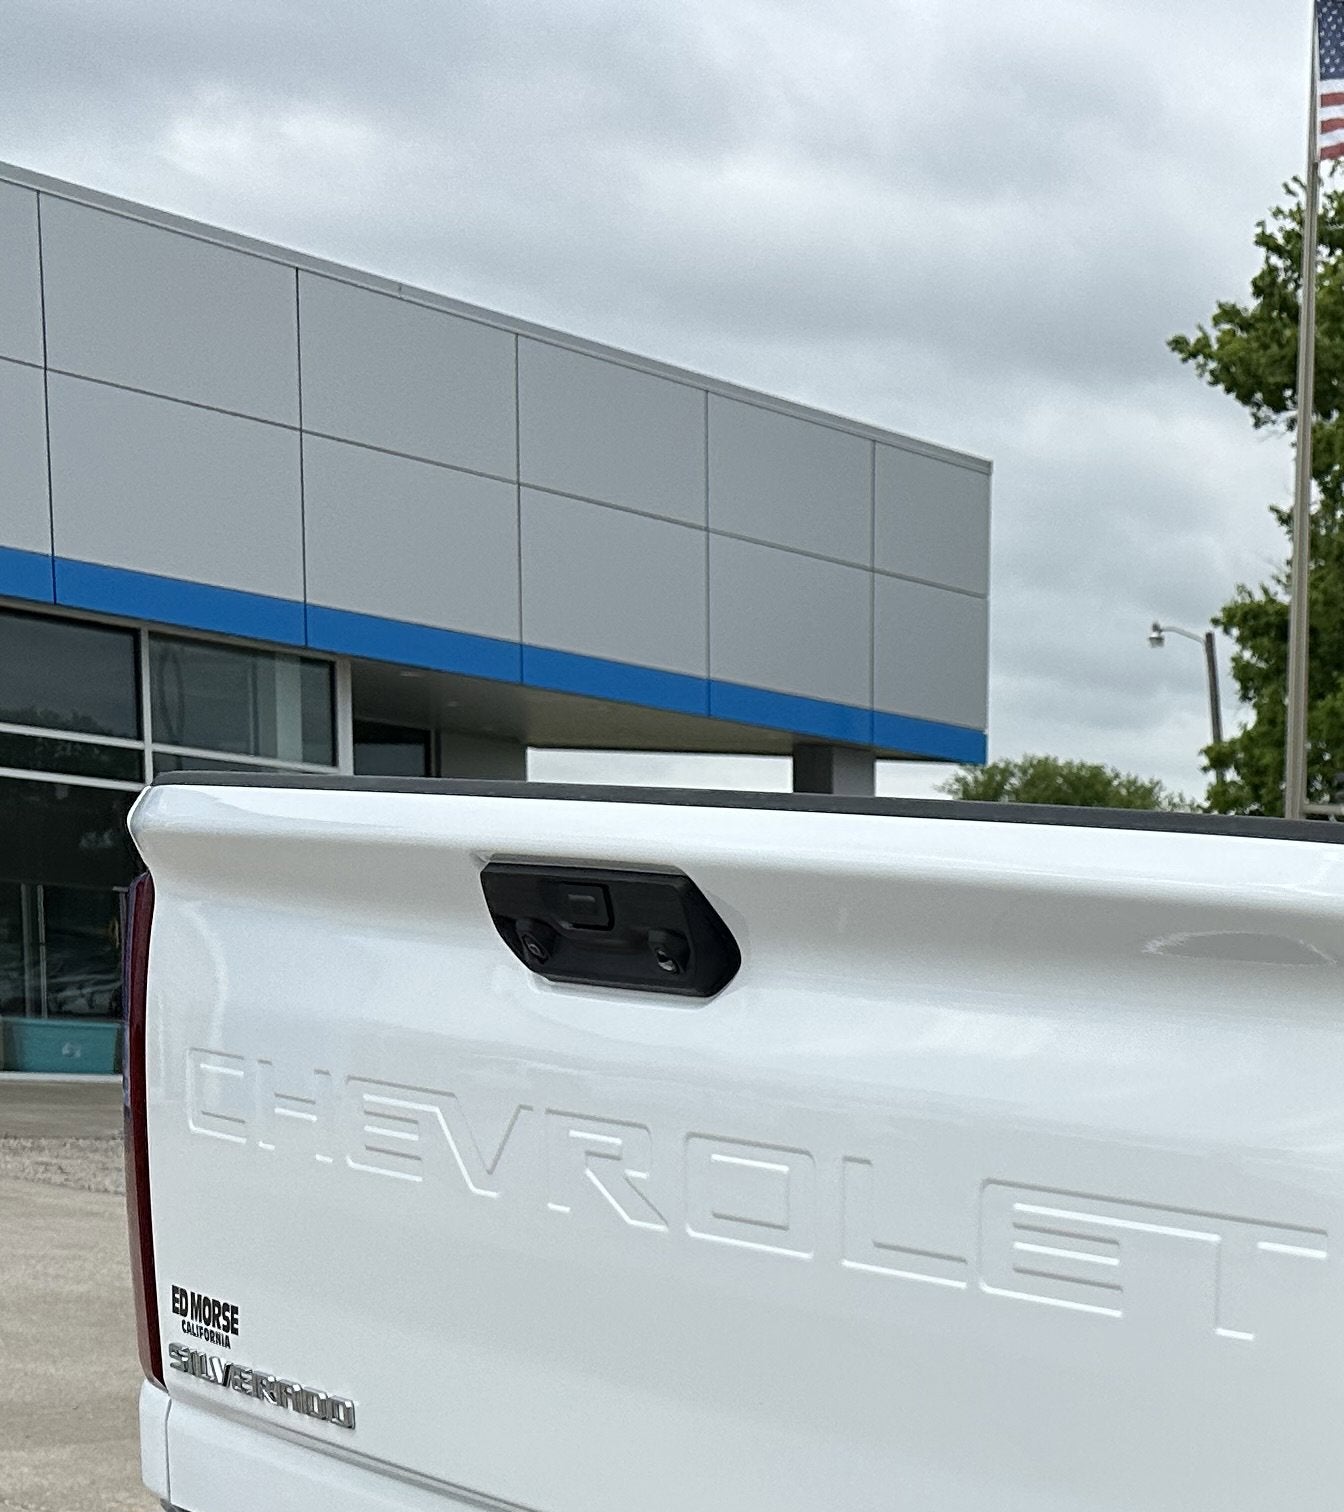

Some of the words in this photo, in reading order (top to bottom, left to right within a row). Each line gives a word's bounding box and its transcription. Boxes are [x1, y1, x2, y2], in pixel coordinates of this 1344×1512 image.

[187, 1048, 1328, 1340] CHEVROLET
[171, 1285, 188, 1317] ED
[190, 1291, 239, 1336] MORSE
[181, 1319, 231, 1349] CALIFORNIA
[168, 1342, 356, 1429] SILVERADO
